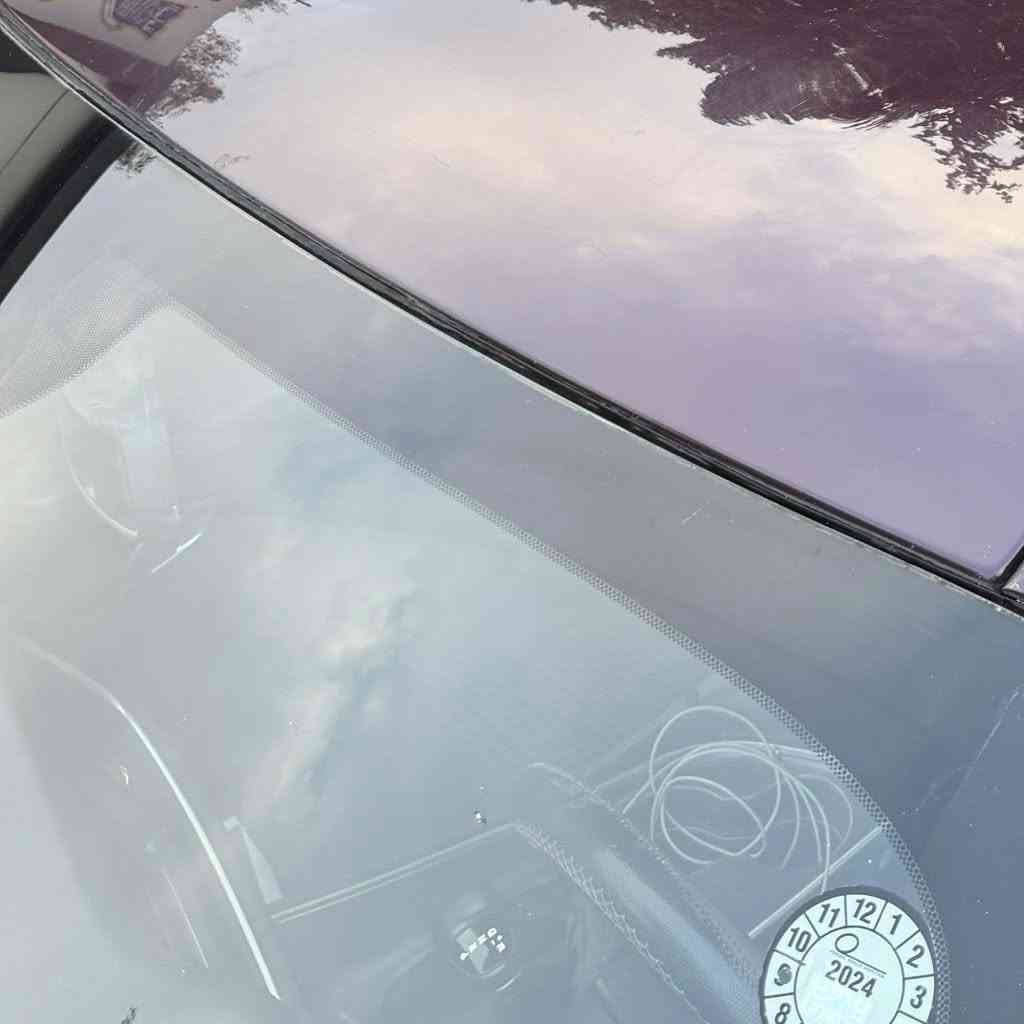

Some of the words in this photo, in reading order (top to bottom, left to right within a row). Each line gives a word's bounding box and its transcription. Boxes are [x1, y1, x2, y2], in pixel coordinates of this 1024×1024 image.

[818, 902, 841, 928] 11
[854, 898, 877, 925] 12
[890, 913, 903, 936] 1
[787, 926, 812, 953] 10
[906, 944, 925, 969] 2
[825, 959, 877, 999] 2024
[910, 985, 927, 1009] 3
[774, 1002, 791, 1024] 8
